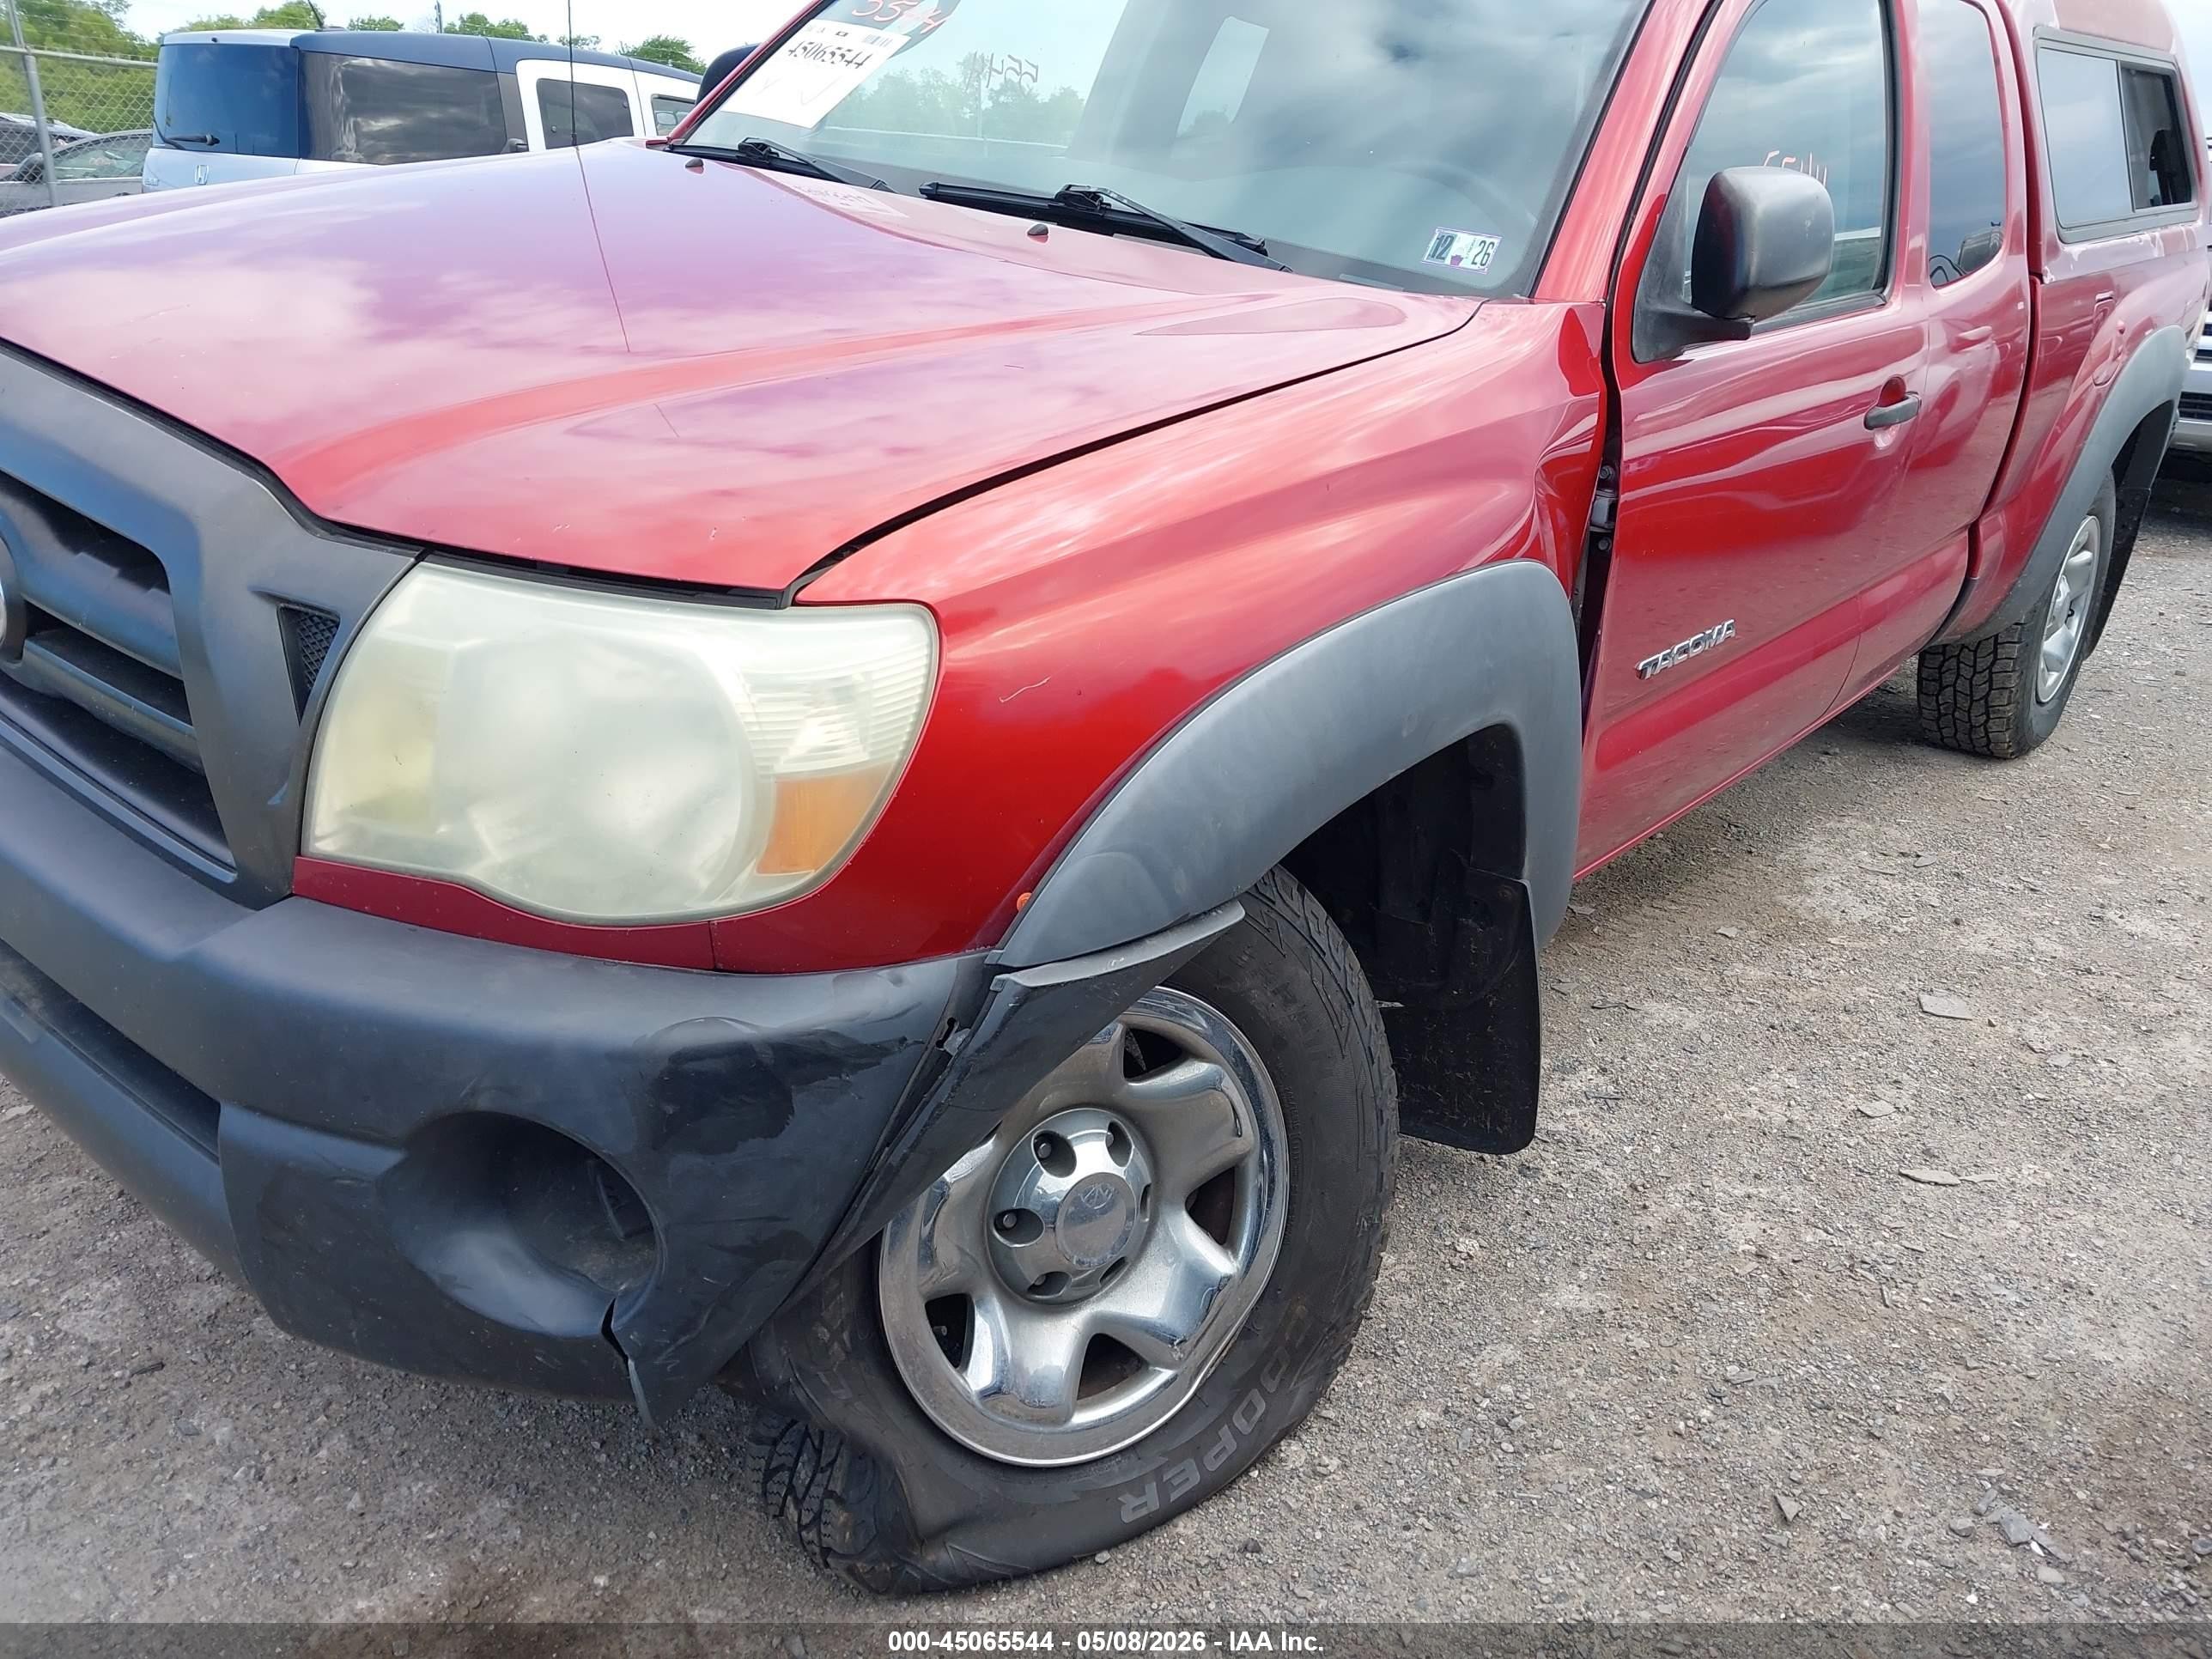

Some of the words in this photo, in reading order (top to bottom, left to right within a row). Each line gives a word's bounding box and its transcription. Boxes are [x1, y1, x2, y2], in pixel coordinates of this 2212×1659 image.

[787, 40, 872, 69] 45065544
[1430, 234, 1455, 260] 12
[1471, 240, 1495, 266] 26
[1636, 618, 1735, 680] TACOMA
[1119, 1309, 1314, 1524] COOPER
